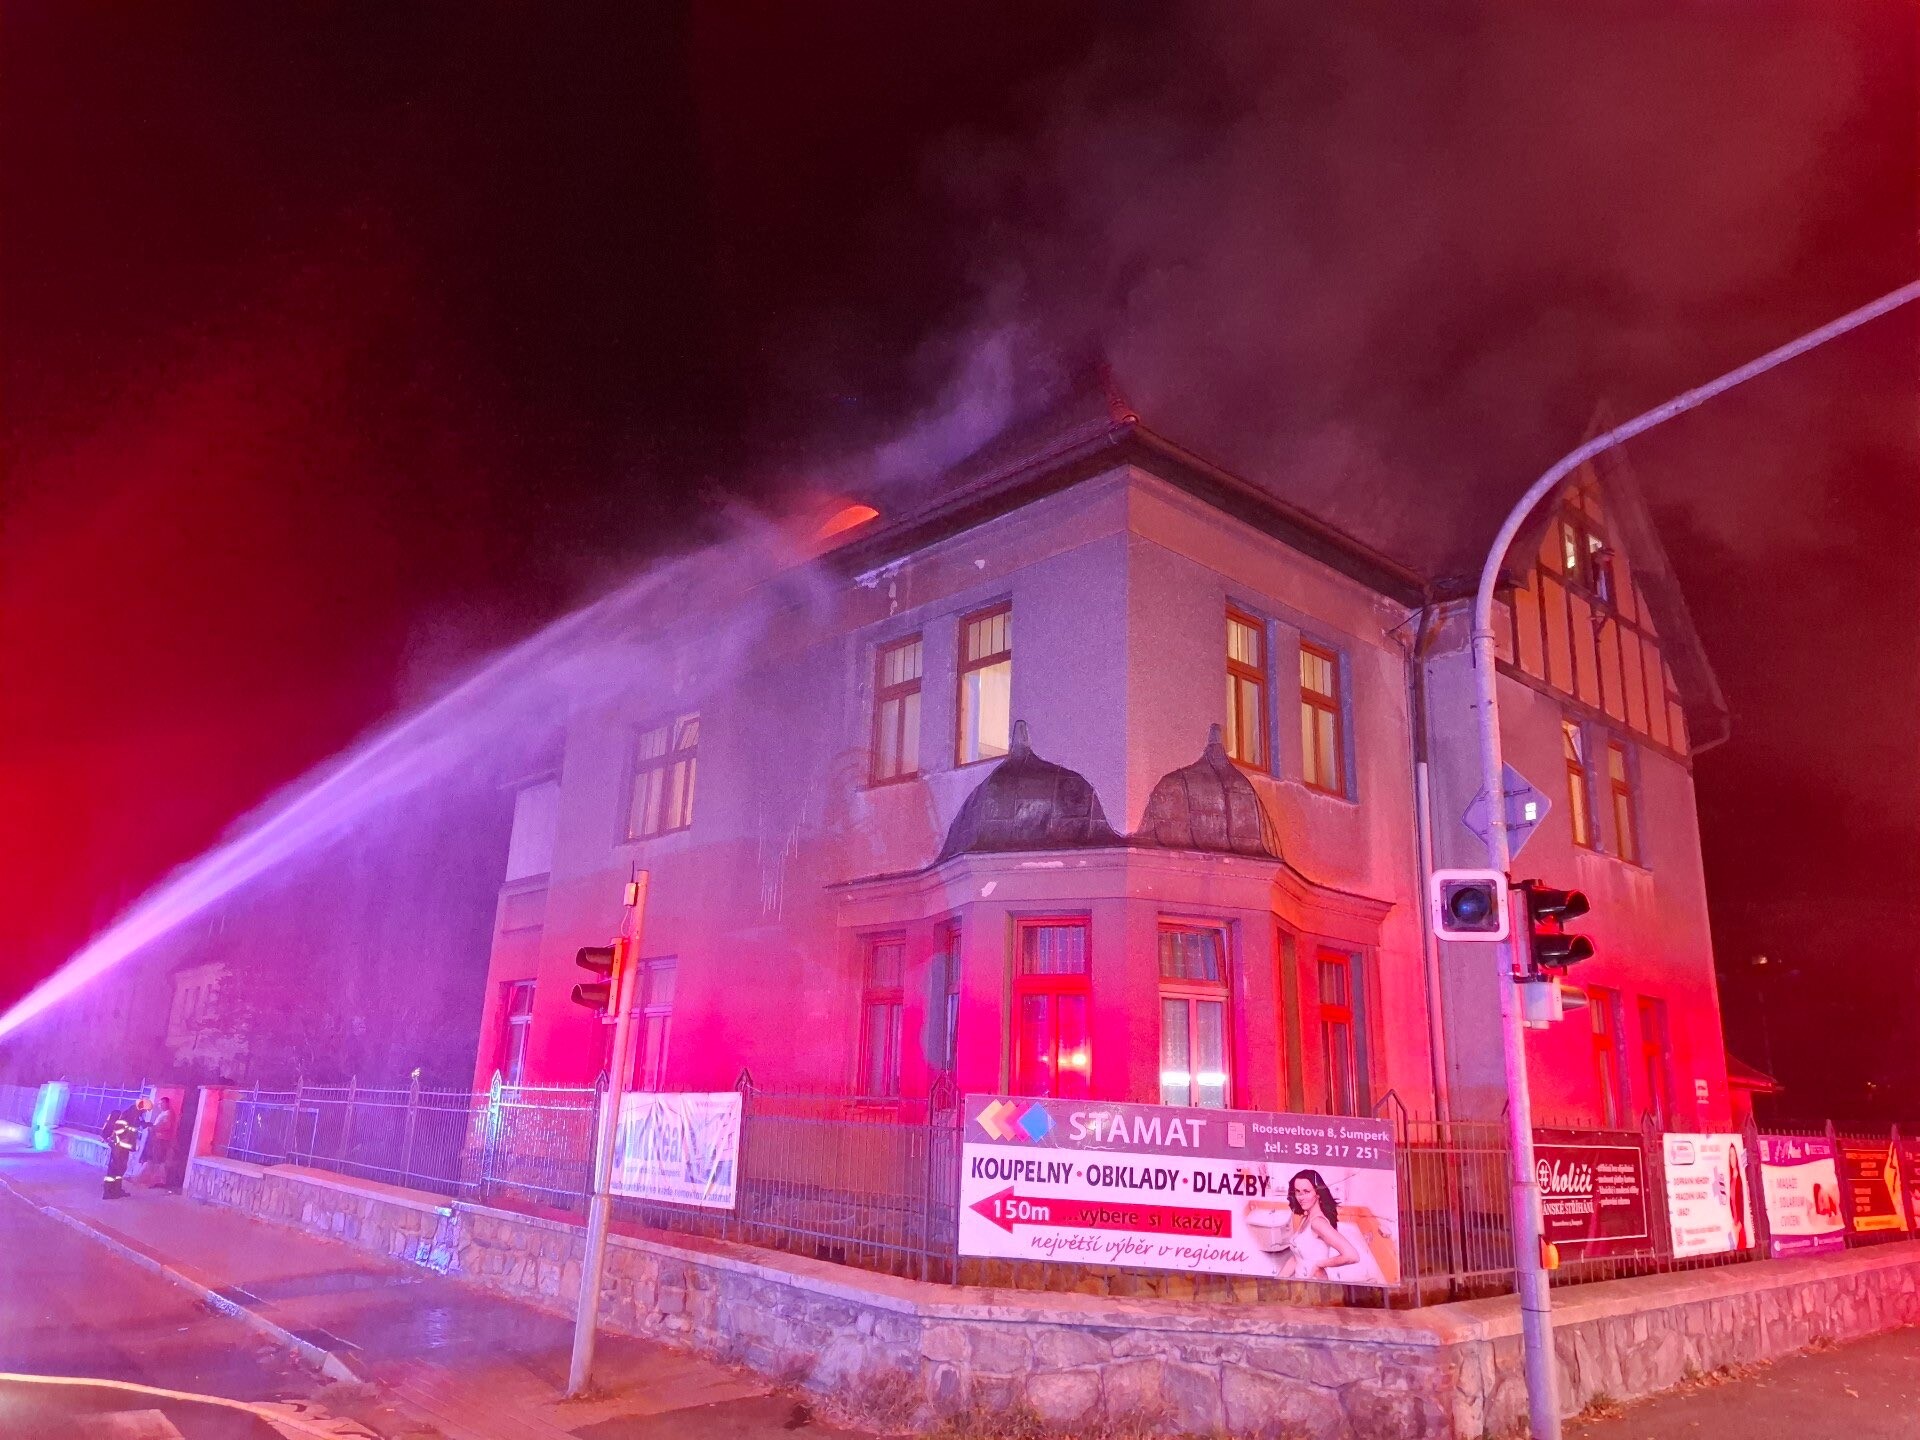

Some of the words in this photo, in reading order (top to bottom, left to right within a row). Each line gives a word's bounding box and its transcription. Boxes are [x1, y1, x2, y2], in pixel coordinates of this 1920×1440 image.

[1069, 1111, 1207, 1148] STAMAT
[1252, 1123, 1325, 1138] Rooseveltova
[1339, 1127, 1390, 1143] Šumperk
[1265, 1142, 1288, 1154] tel.:
[1294, 1143, 1319, 1156] 583
[1325, 1144, 1349, 1158] 217
[1356, 1147, 1379, 1160] 251
[971, 1156, 1073, 1184] KOUPELNY
[1086, 1164, 1180, 1191] OBKLADY
[1193, 1168, 1270, 1197] DLAŽBY
[993, 1199, 1049, 1221] 150m
[1543, 1200, 1565, 1215] ÁNSKÉ
[1149, 1211, 1162, 1227] si
[1031, 1232, 1102, 1256] největší
[1106, 1236, 1155, 1262] výběr
[1158, 1245, 1173, 1257] v
[1175, 1244, 1249, 1267] regionu
